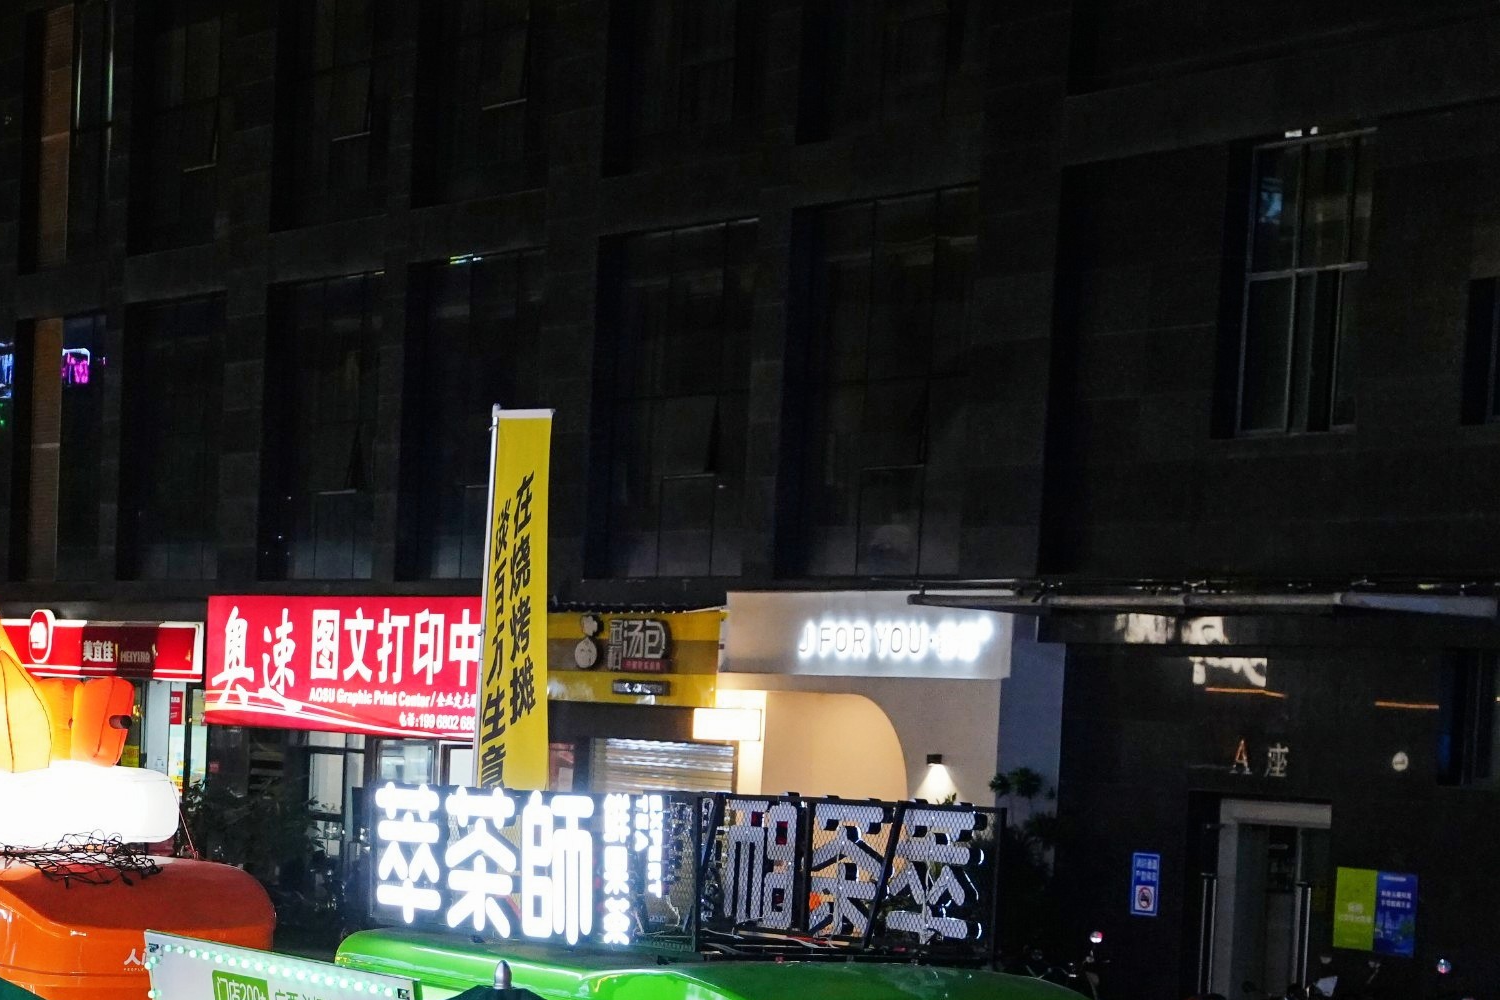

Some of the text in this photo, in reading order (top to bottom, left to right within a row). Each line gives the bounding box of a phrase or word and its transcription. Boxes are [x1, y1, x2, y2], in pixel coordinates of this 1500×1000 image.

[509, 470, 536, 726] 在烧烤摊
[82, 640, 114, 663] 美宜佳
[480, 498, 512, 789] 谈百万生意
[623, 619, 666, 659] 汤包
[818, 622, 868, 656] FOR
[874, 622, 926, 657] YOU
[212, 606, 482, 711] 奥速 图文打印中
[336, 688, 373, 707] Graphic
[374, 689, 398, 706] Print
[399, 690, 431, 707] Center
[123, 948, 147, 966] 人
